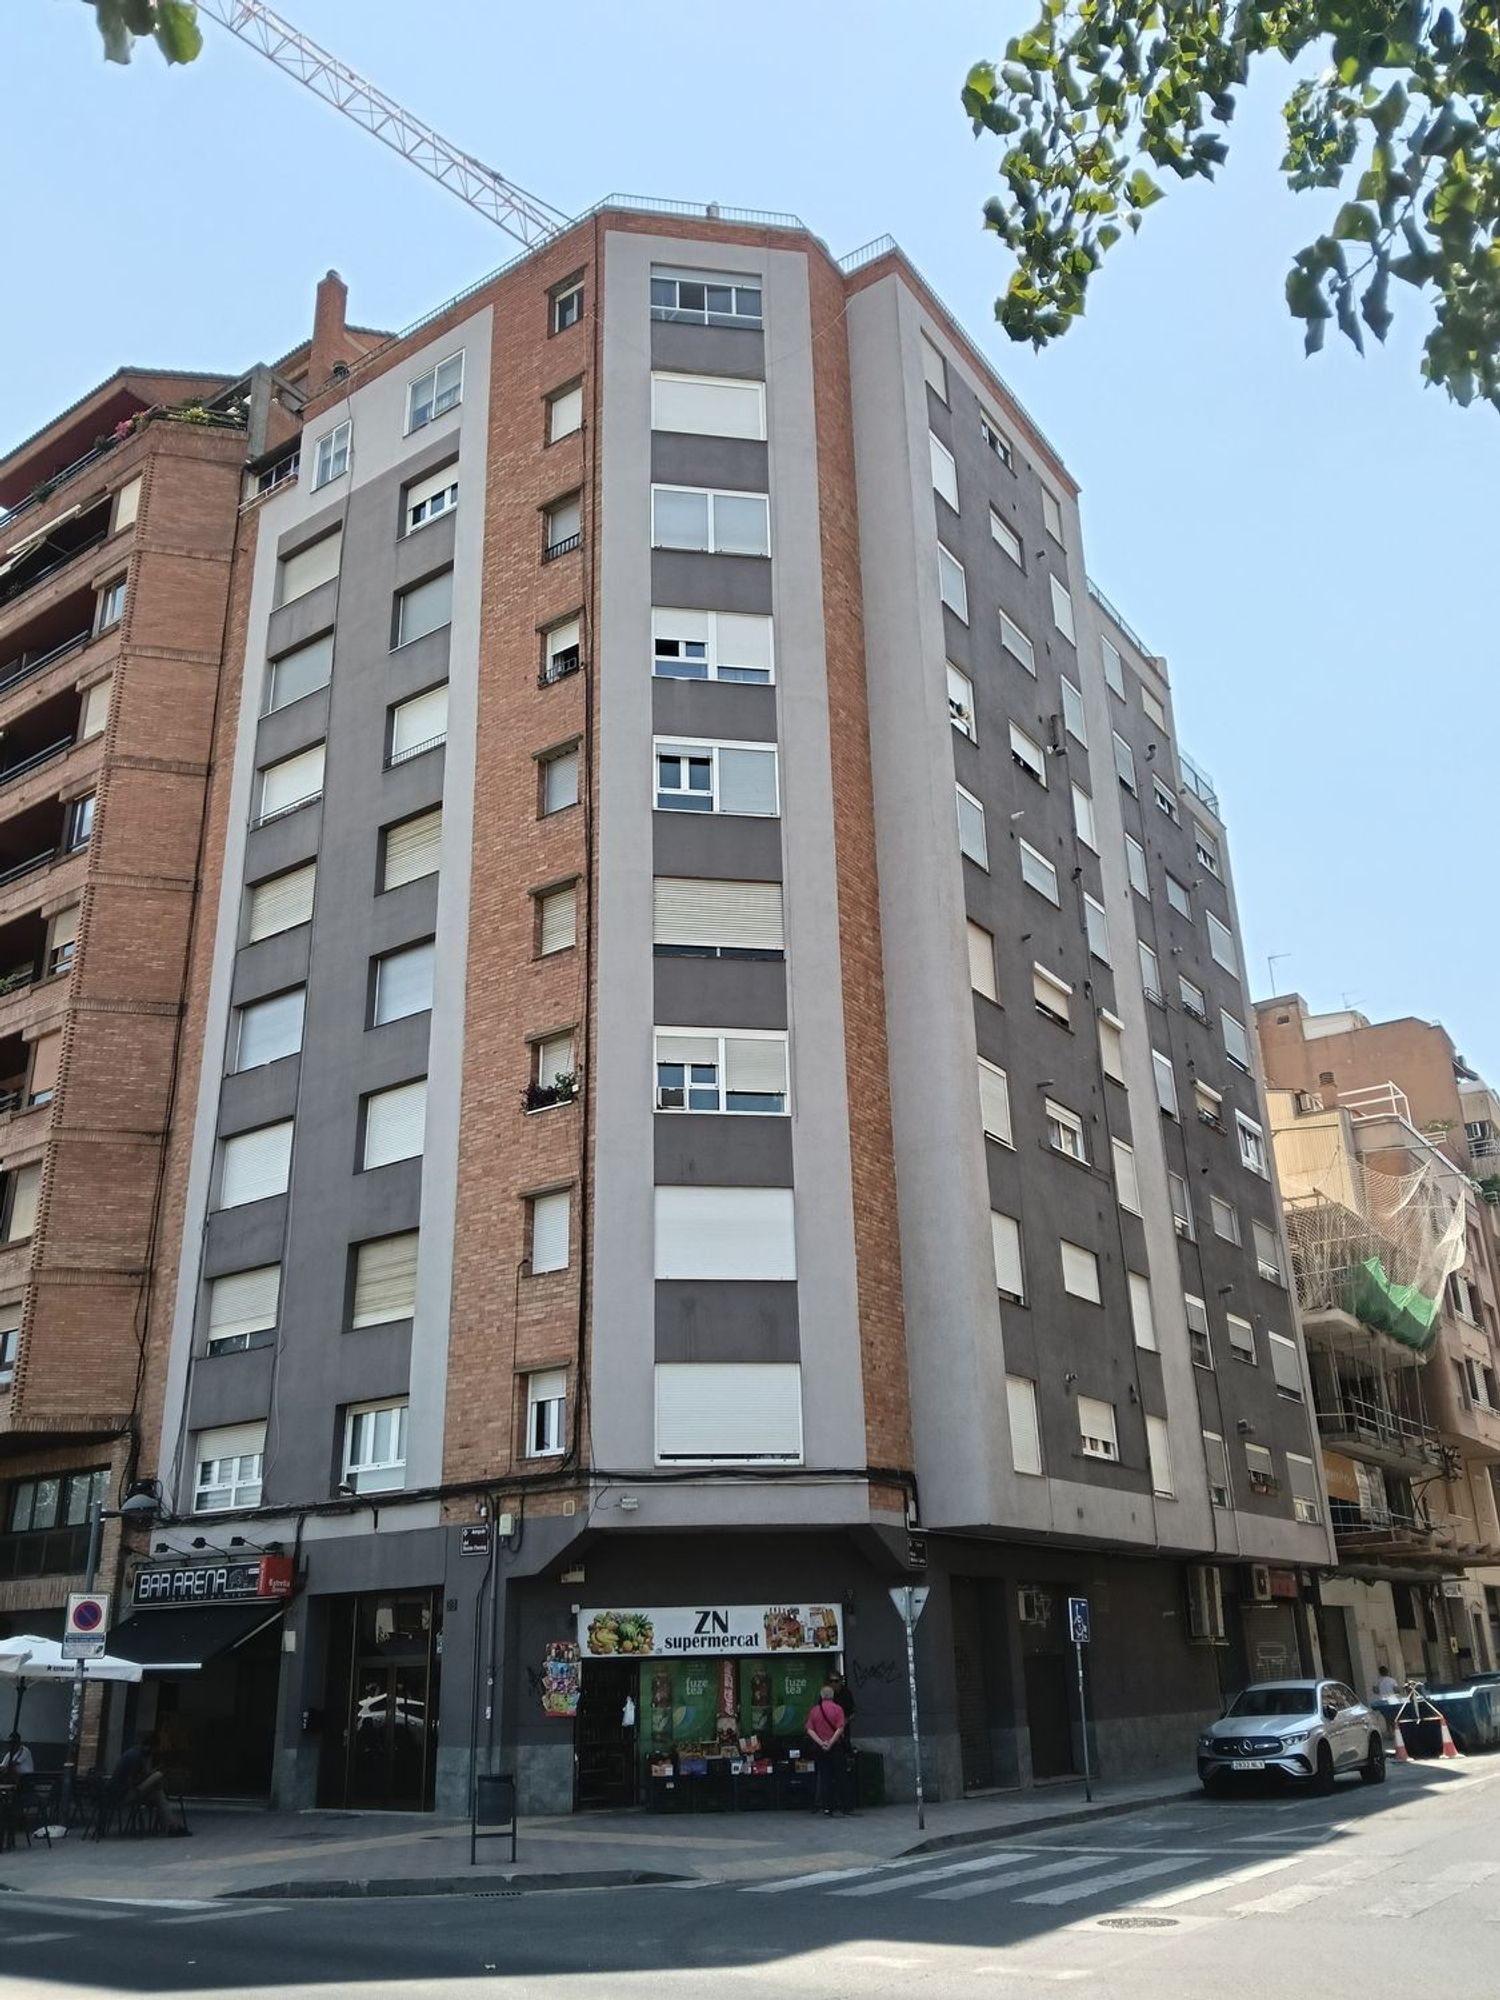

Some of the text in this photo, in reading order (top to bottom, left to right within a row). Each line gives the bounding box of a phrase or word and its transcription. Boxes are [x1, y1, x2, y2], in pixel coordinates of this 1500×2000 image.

[139, 1573, 170, 1598] BAR
[173, 1569, 227, 1596] ARENA
[694, 1610, 728, 1635] ZN
[664, 1632, 759, 1651] supermercat
[686, 1676, 708, 1687] fuze
[785, 1676, 807, 1687] fuze
[686, 1685, 703, 1695] tea
[785, 1685, 801, 1695] tea
